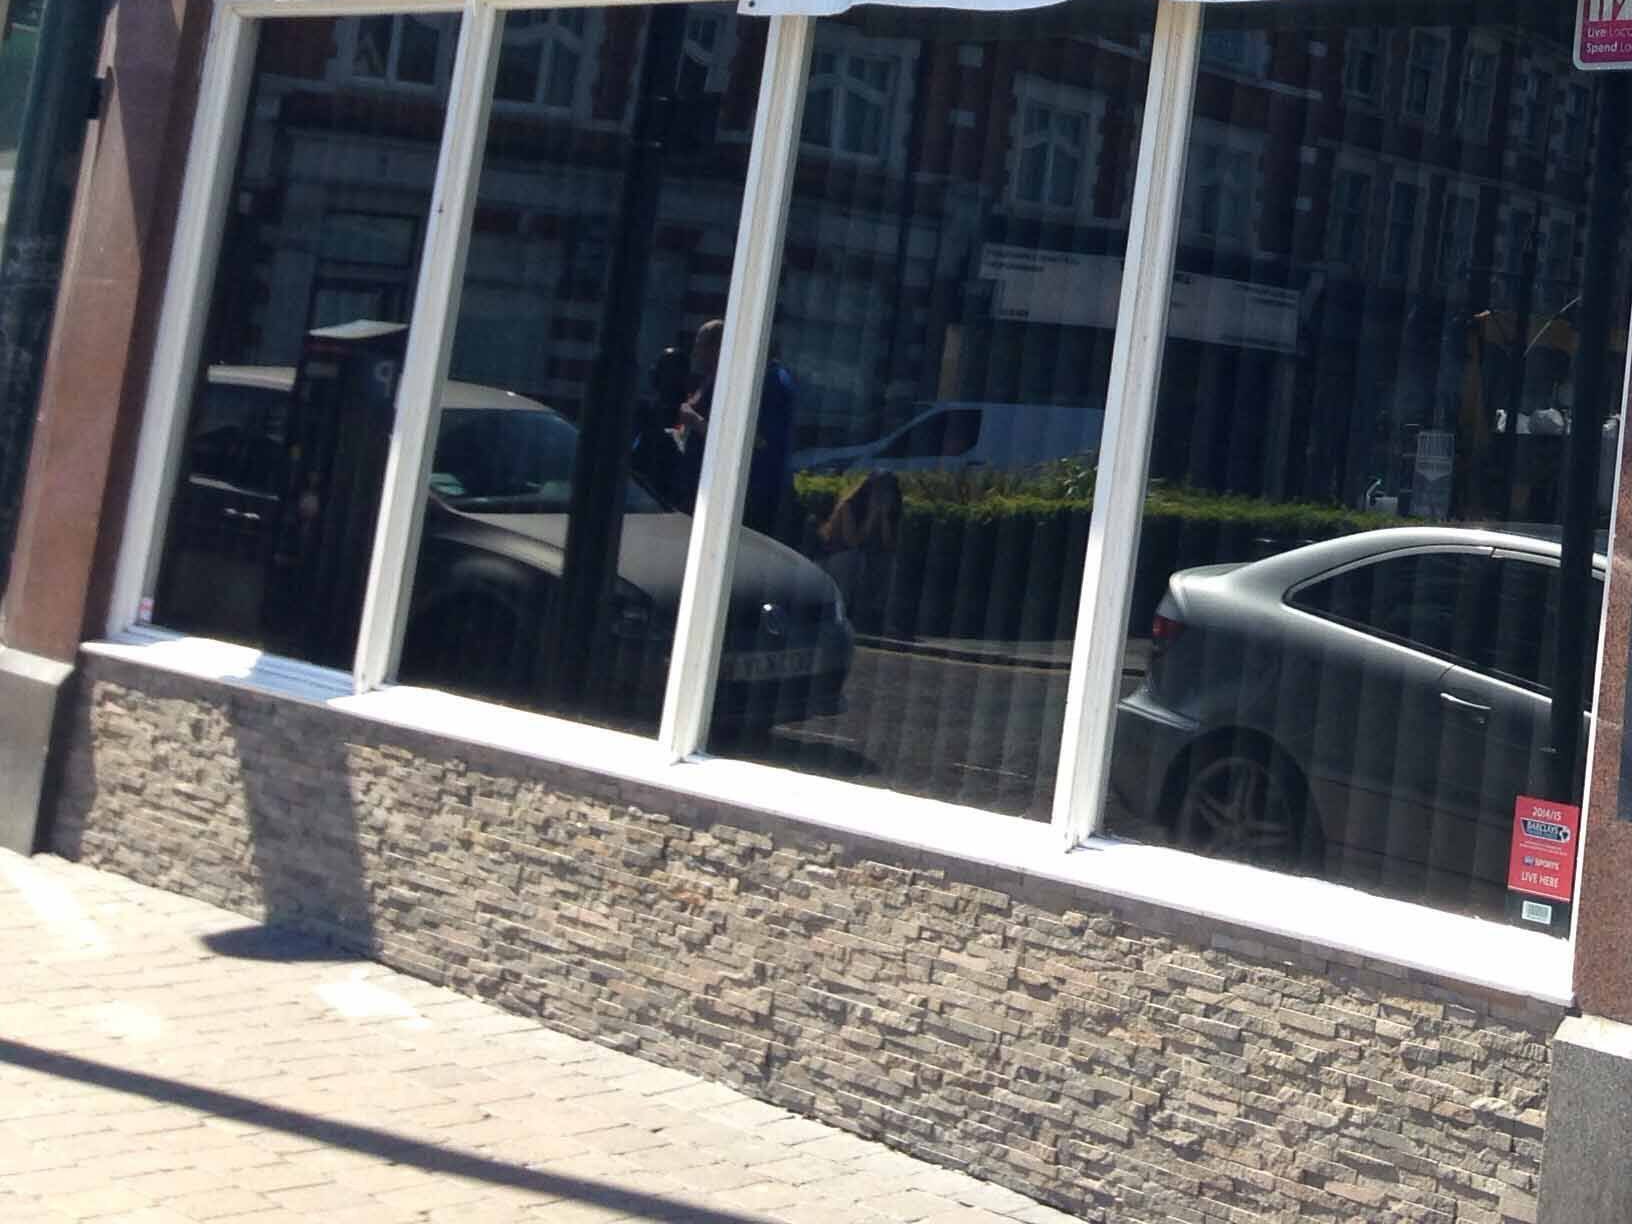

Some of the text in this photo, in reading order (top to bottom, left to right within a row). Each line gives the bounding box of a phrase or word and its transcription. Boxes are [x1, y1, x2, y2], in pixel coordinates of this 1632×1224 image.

[1587, 25, 1608, 38] Live
[1586, 41, 1618, 55] Spend
[1521, 871, 1559, 888] LIVE HERE
